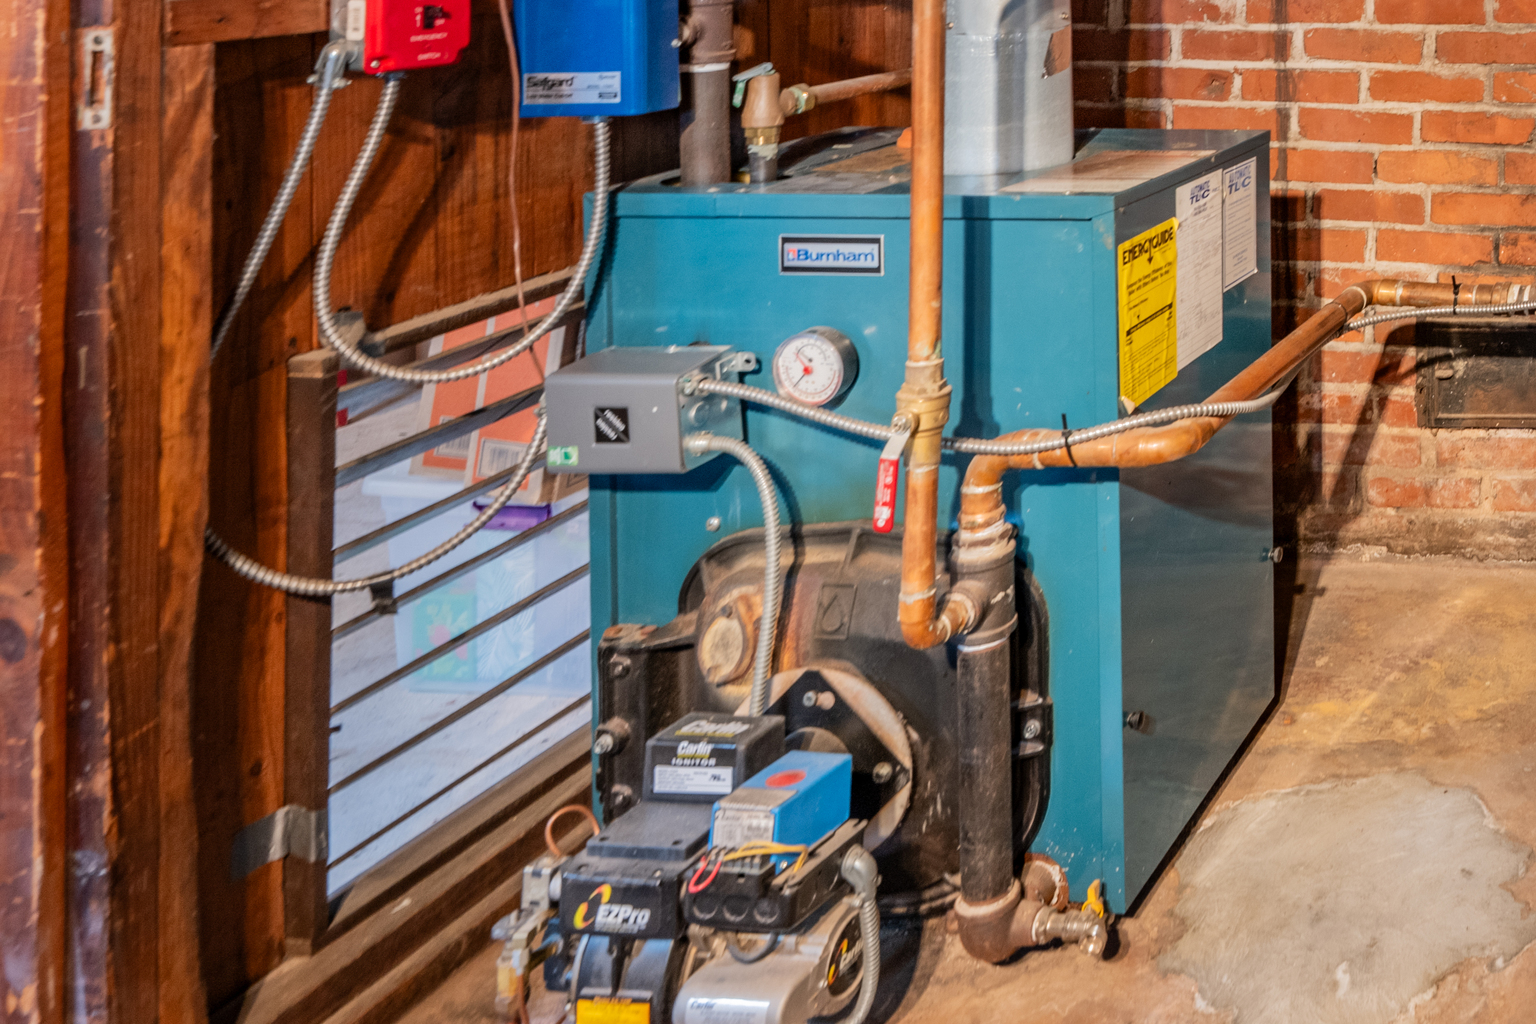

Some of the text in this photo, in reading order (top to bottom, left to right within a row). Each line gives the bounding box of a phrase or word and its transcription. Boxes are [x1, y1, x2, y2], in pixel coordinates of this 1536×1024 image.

[797, 248, 874, 262] Burnham
[677, 741, 712, 755] Carlin
[671, 758, 716, 767] IGNITOR
[596, 904, 651, 925] EZPro
